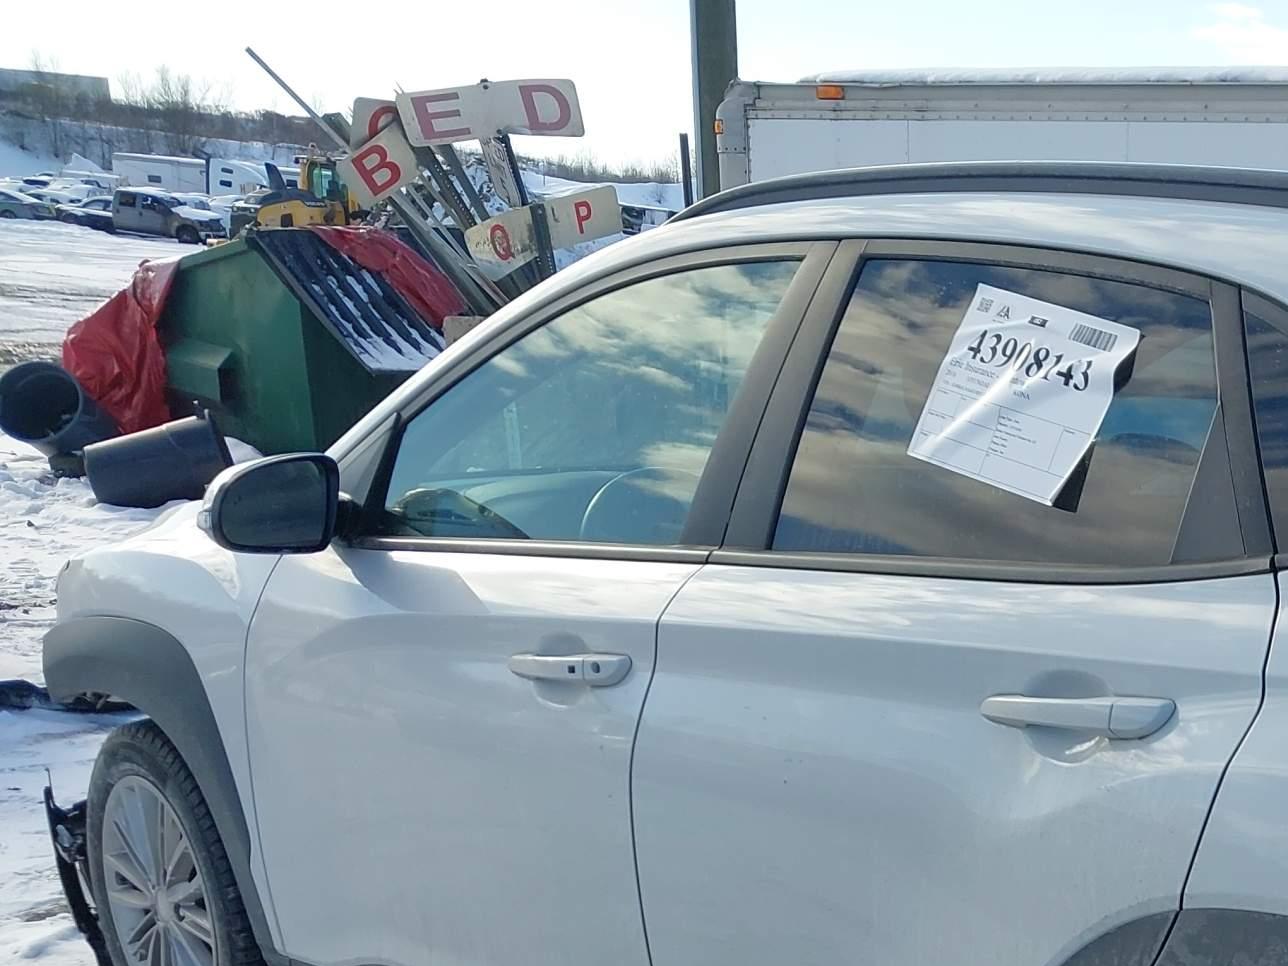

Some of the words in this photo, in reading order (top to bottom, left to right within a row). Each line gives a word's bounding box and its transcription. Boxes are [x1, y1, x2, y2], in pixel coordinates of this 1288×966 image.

[410, 92, 472, 140] E
[518, 83, 571, 132] D
[351, 144, 402, 198] B
[489, 223, 515, 262] Q
[573, 200, 592, 235] P
[967, 329, 1093, 392] 43908143
